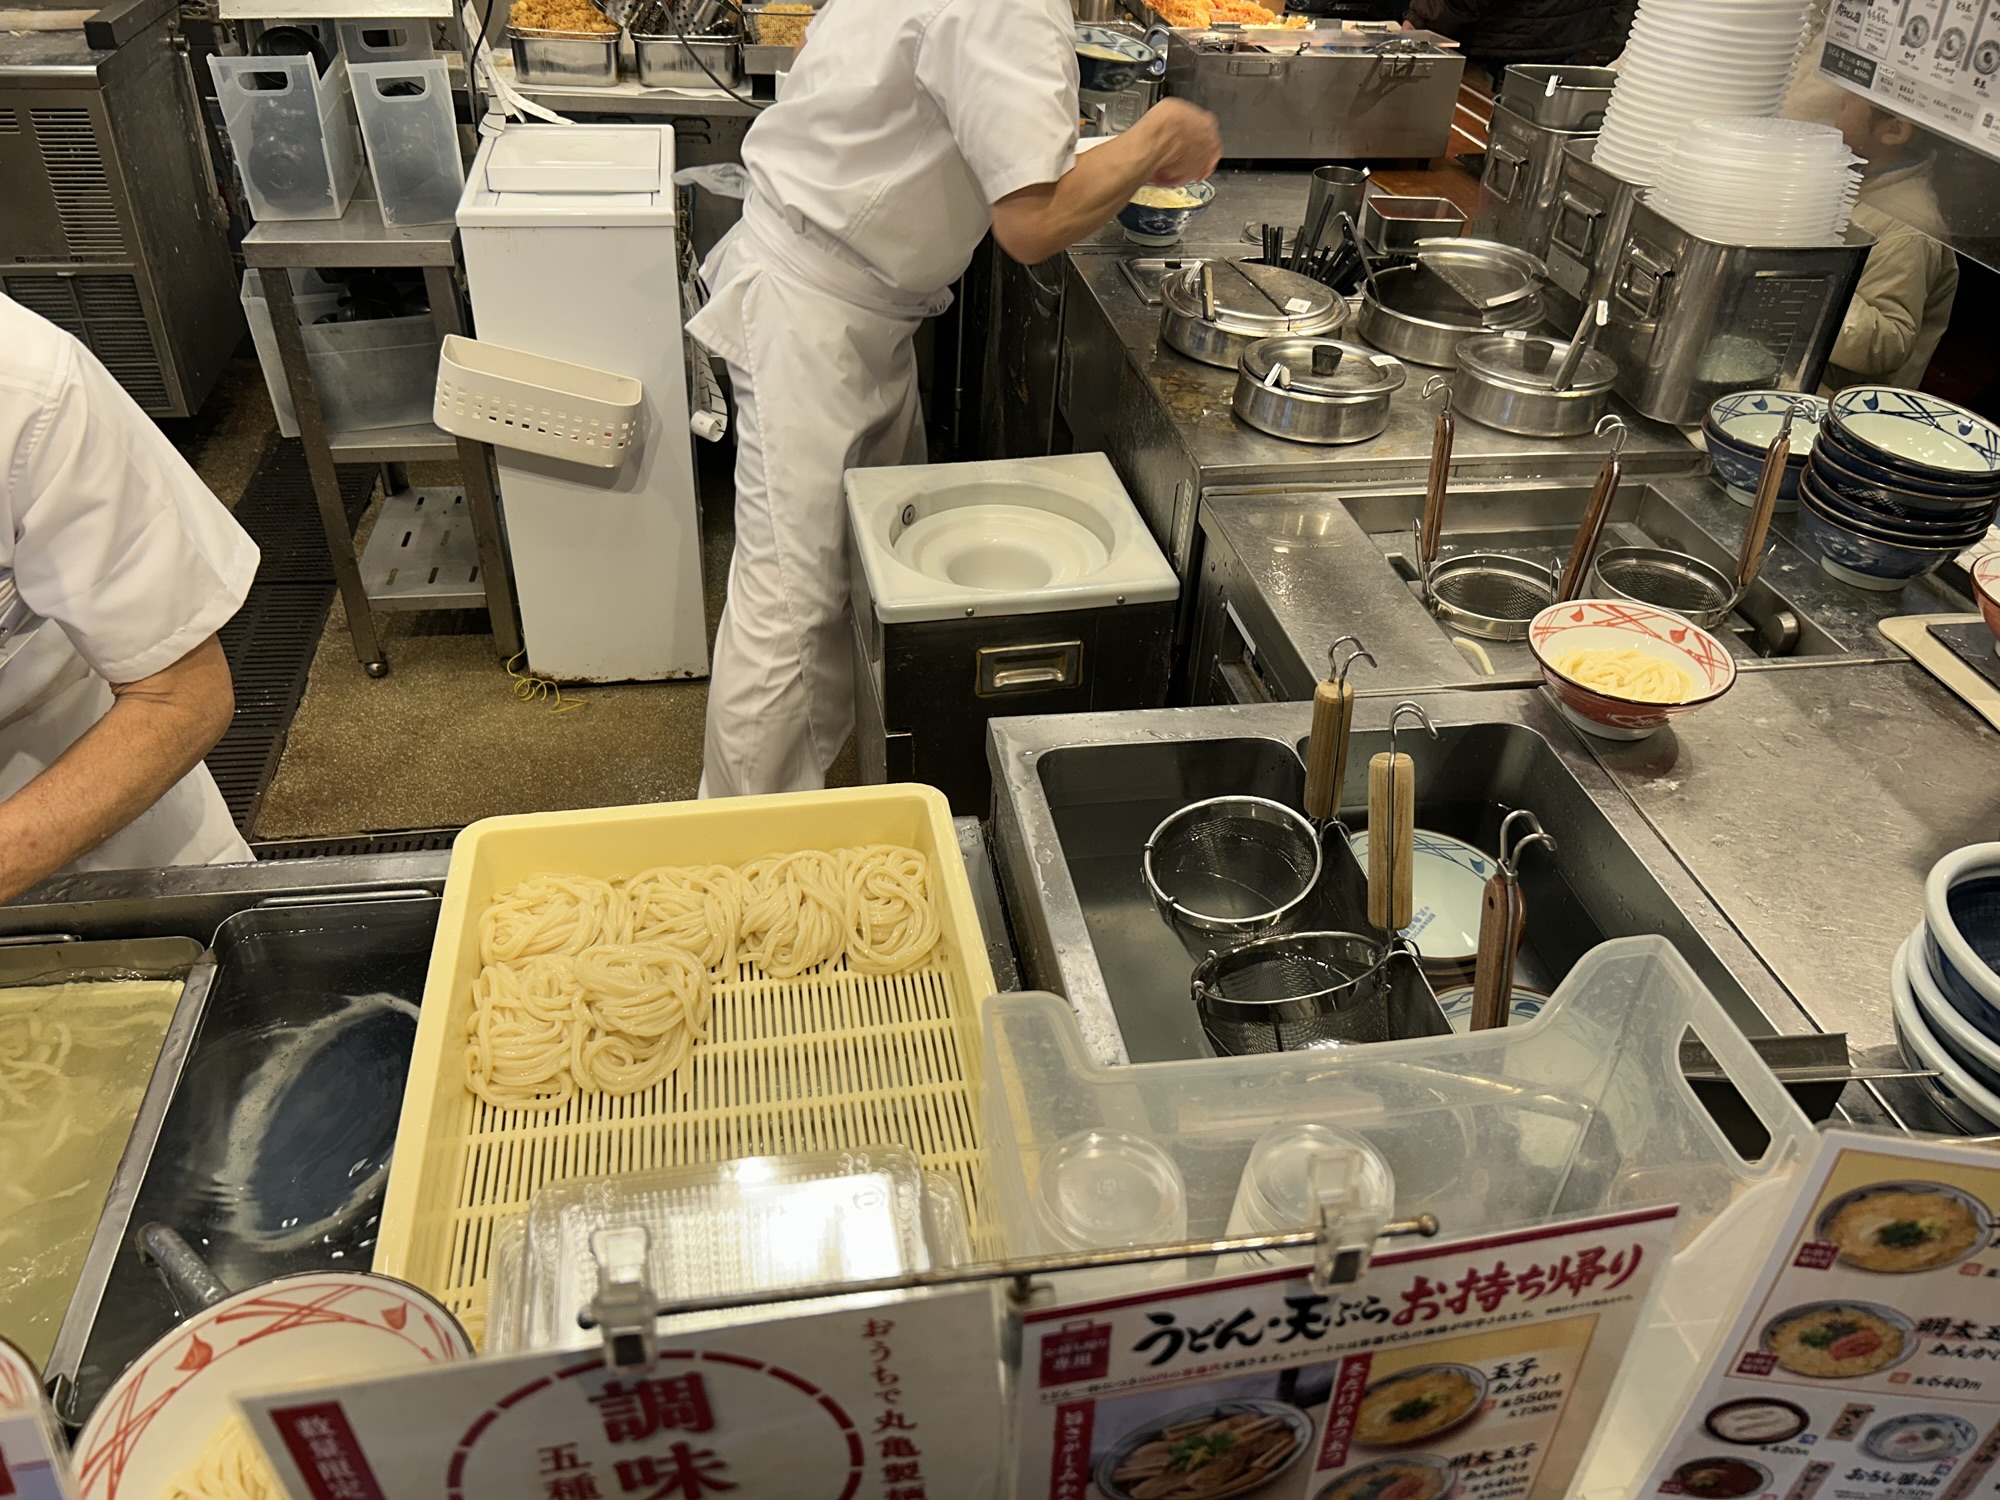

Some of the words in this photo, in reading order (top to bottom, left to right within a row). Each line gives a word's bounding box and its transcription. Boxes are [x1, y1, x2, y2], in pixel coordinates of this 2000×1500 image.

[1131, 1243, 1643, 1367] うどん・天ぷらお持ち帰り
[1487, 1357, 1539, 1381] 玉子
